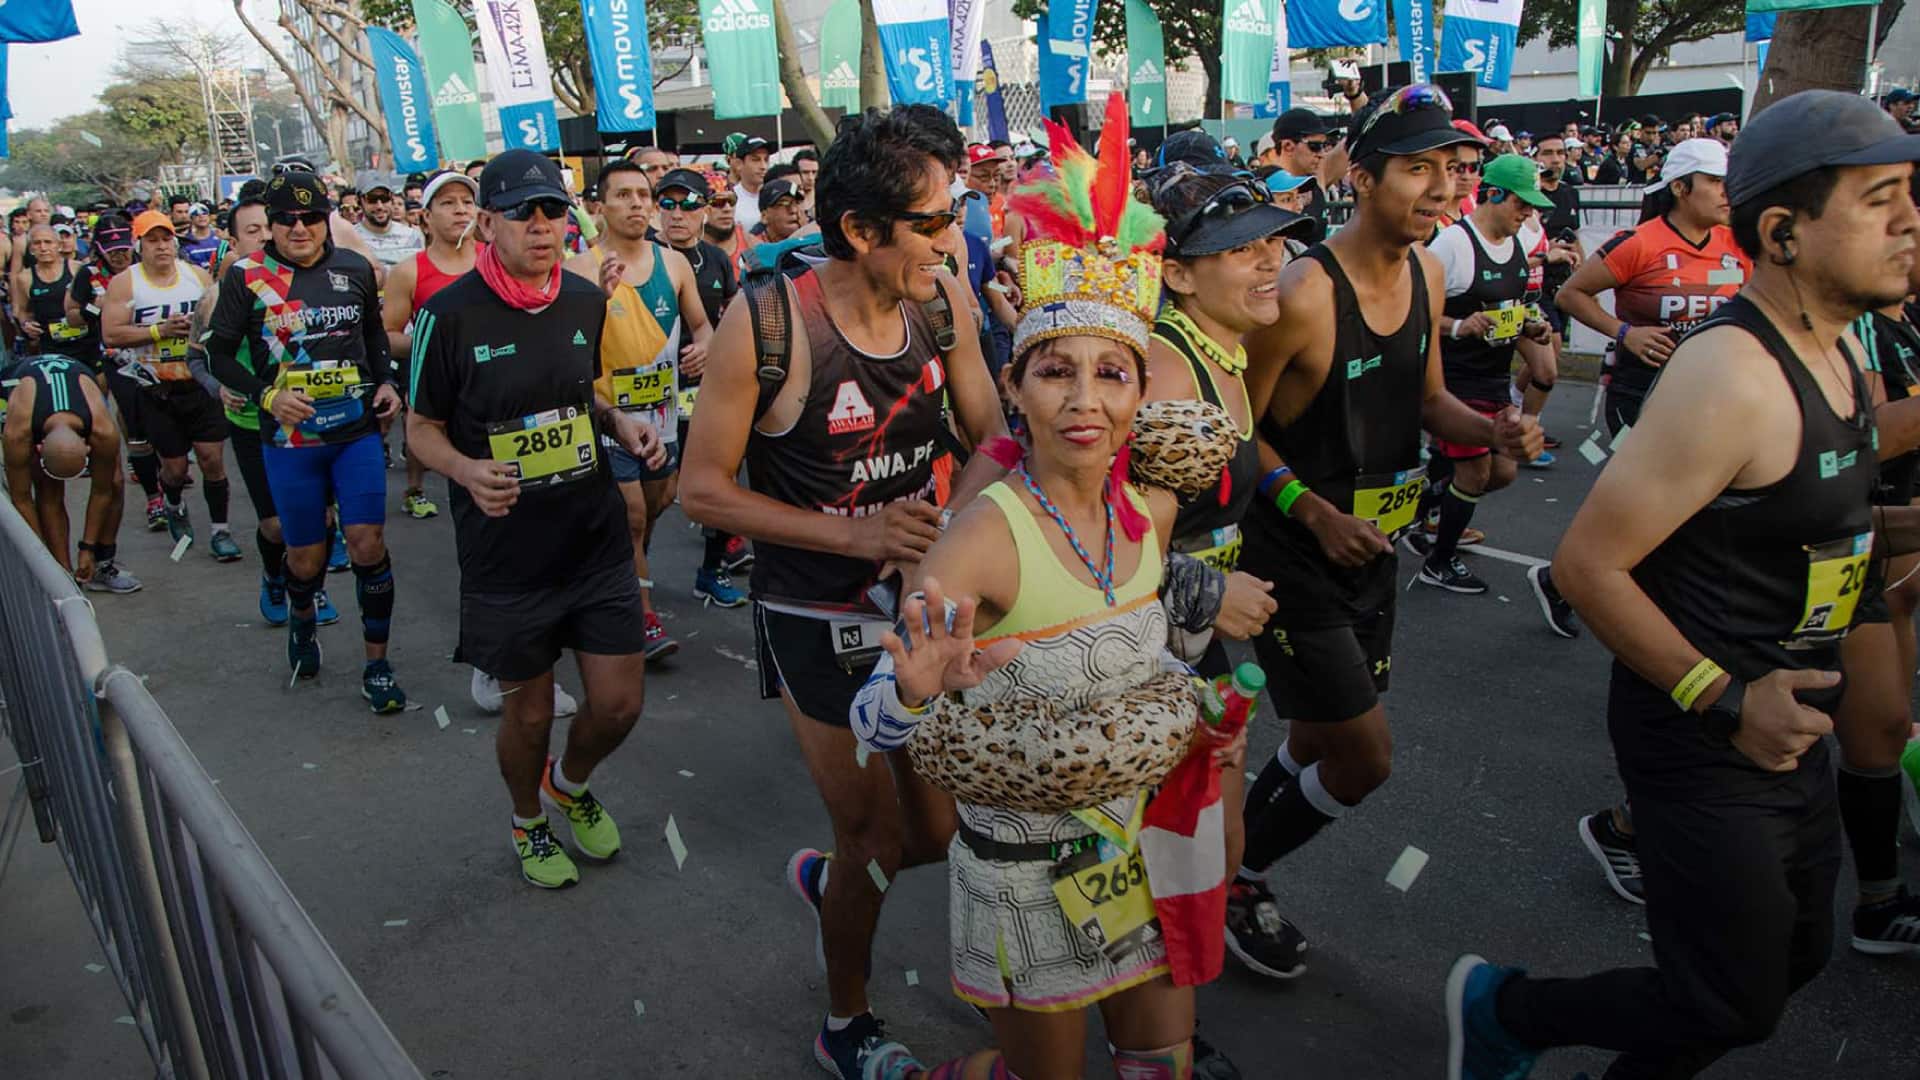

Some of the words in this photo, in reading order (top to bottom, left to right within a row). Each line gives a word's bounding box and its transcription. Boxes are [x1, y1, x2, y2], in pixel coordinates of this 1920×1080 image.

[706, 13, 770, 32] adidas
[1410, 0, 1425, 84] movistar
[929, 36, 945, 99] movistar
[1484, 34, 1499, 84] movistar
[393, 56, 419, 136] movistar
[305, 371, 344, 387] 1656
[633, 374, 660, 391] 573
[513, 424, 573, 457] 2887
[1085, 854, 1146, 908] 265
